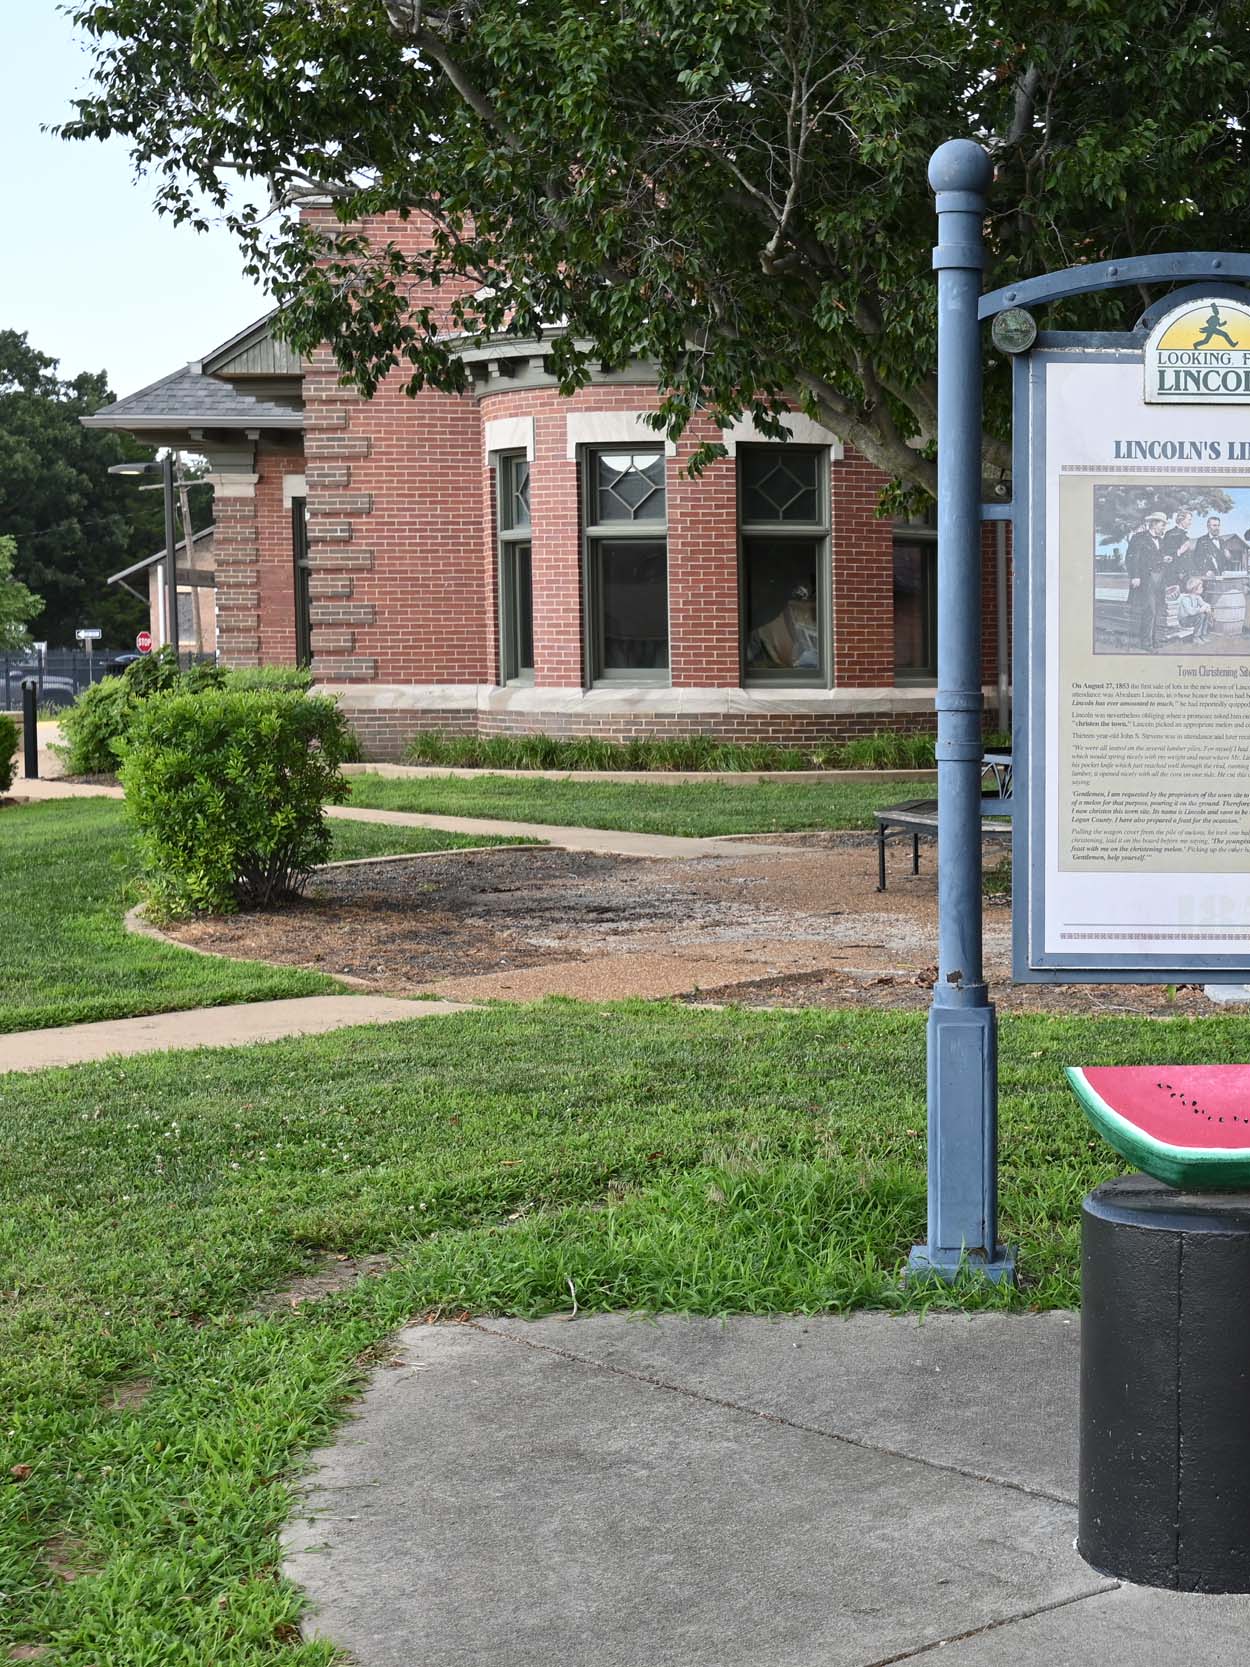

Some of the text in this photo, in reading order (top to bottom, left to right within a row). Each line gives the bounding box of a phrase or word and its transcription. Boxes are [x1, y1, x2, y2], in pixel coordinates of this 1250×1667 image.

[1158, 352, 1231, 365] LOOKING
[1113, 440, 1221, 460] LINCOLN'S
[138, 637, 152, 647] STOP
[1177, 665, 1197, 677] Town
[1198, 665, 1238, 679] Christening
[1083, 683, 1104, 691] August
